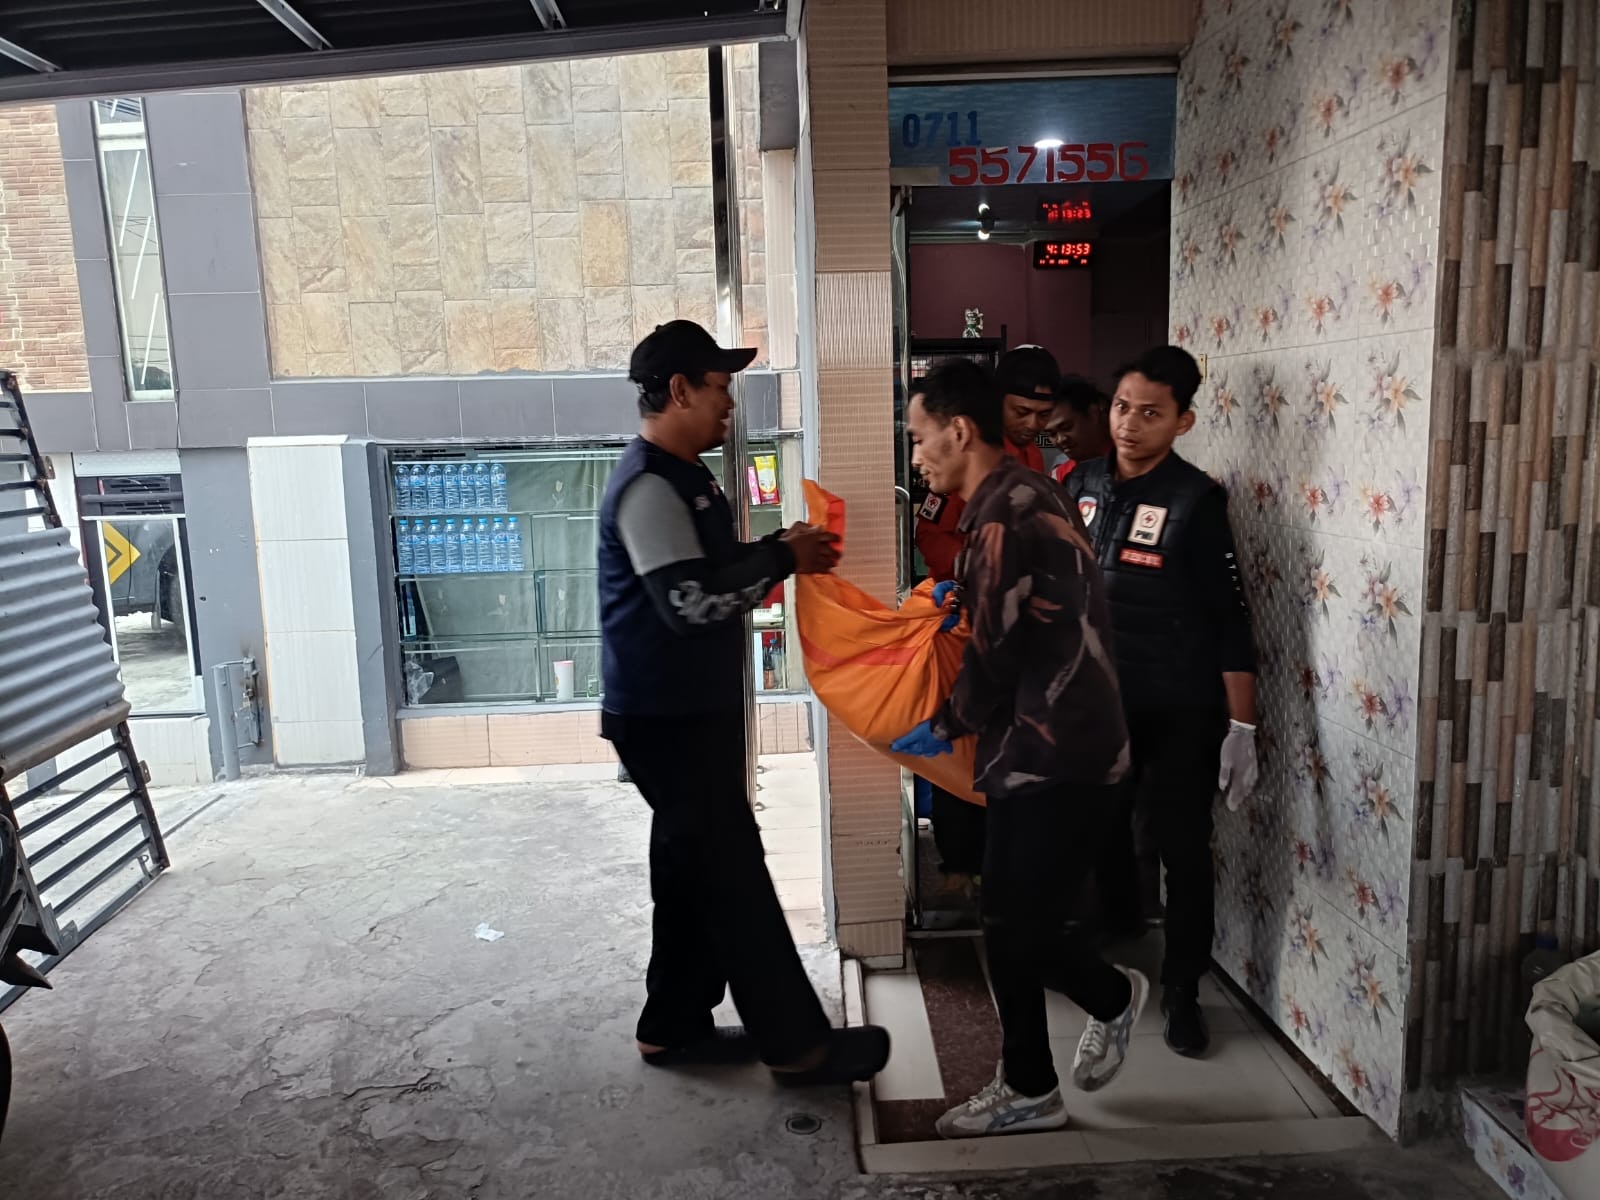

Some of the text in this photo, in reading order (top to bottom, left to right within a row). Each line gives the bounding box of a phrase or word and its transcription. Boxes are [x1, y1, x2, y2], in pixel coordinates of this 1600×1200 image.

[902, 110, 983, 148] 0711
[948, 141, 1149, 187] 5571556
[1046, 243, 1091, 255] 4:13:53
